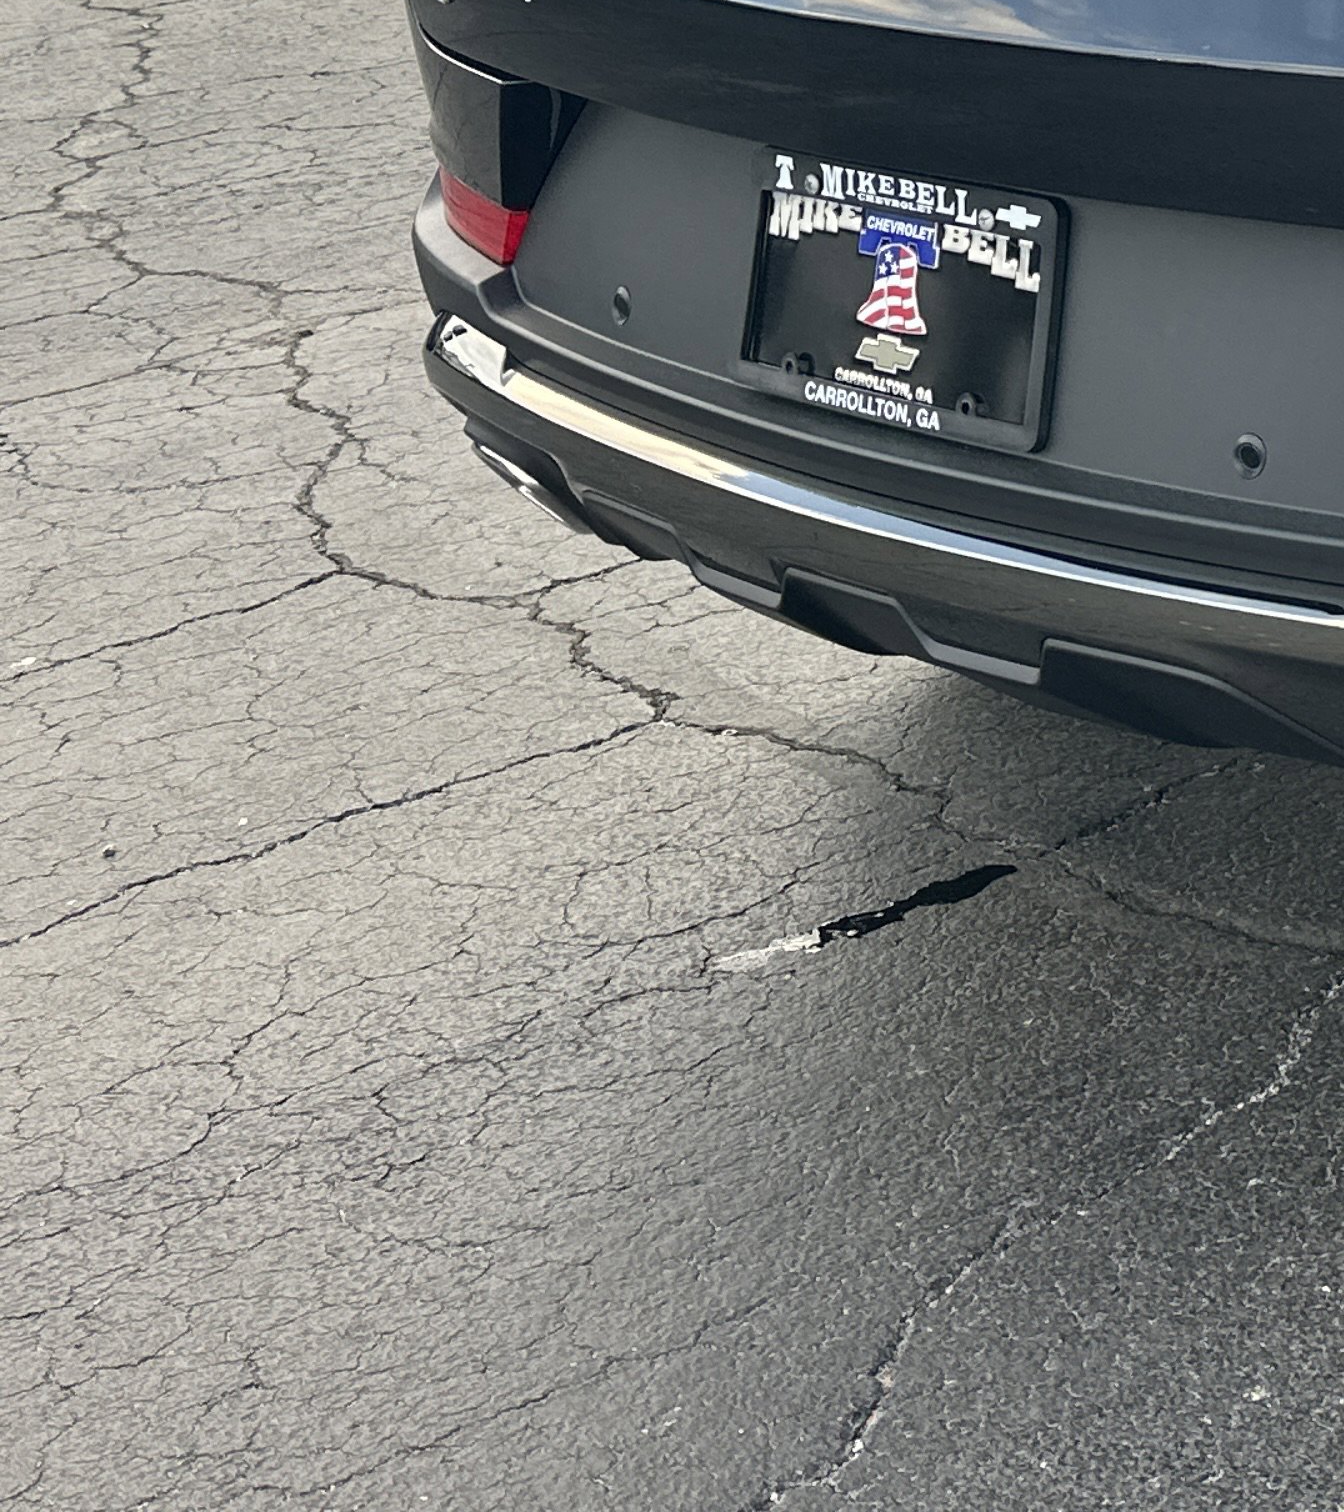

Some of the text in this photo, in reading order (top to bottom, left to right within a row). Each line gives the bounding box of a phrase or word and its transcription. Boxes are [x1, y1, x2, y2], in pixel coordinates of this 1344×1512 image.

[820, 162, 978, 226] MIKE BELL
[857, 191, 934, 215] CHEVROLET
[769, 191, 1041, 293] MIKE BELL
[866, 215, 937, 242] CHEVROLET
[804, 380, 941, 431] CARROLLTON, GA
[834, 366, 933, 405] CARROLLTON, GA
